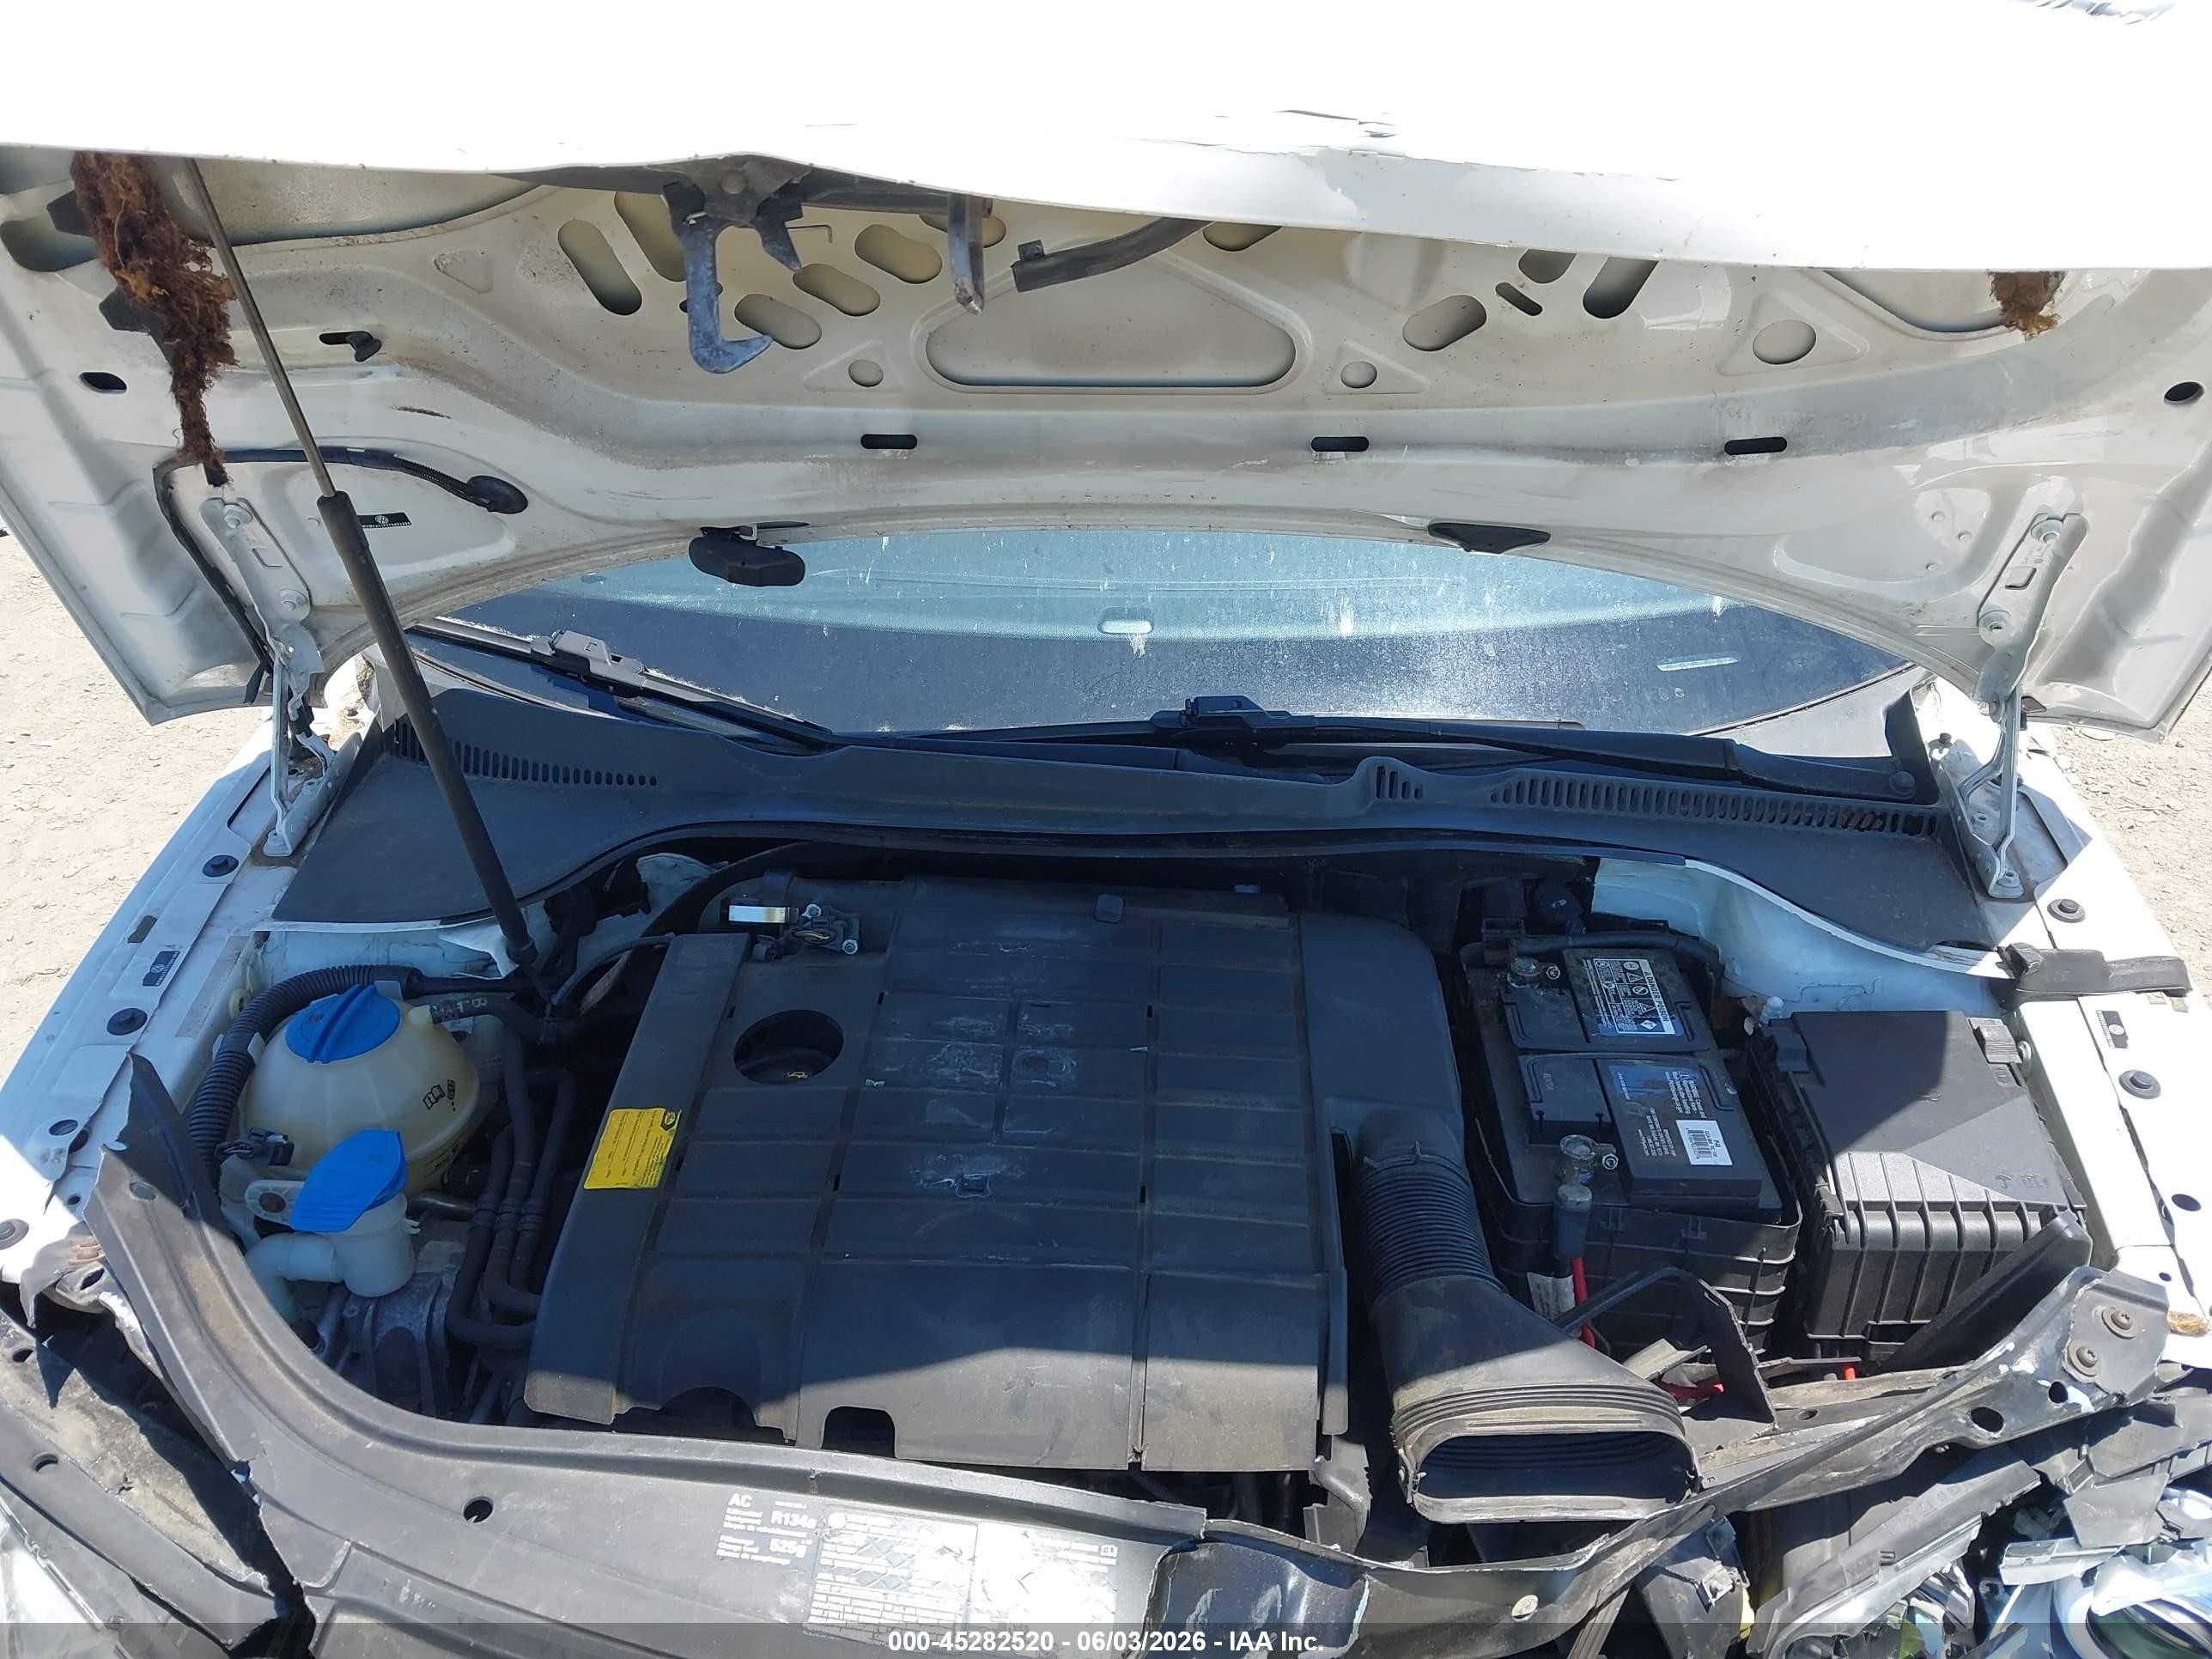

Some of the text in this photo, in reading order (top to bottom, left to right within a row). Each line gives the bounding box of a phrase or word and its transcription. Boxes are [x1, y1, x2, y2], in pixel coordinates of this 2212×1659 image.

[1646, 976, 1670, 1022] DANGER/POISON
[727, 1492, 753, 1508] AC
[770, 1510, 817, 1529] R134a
